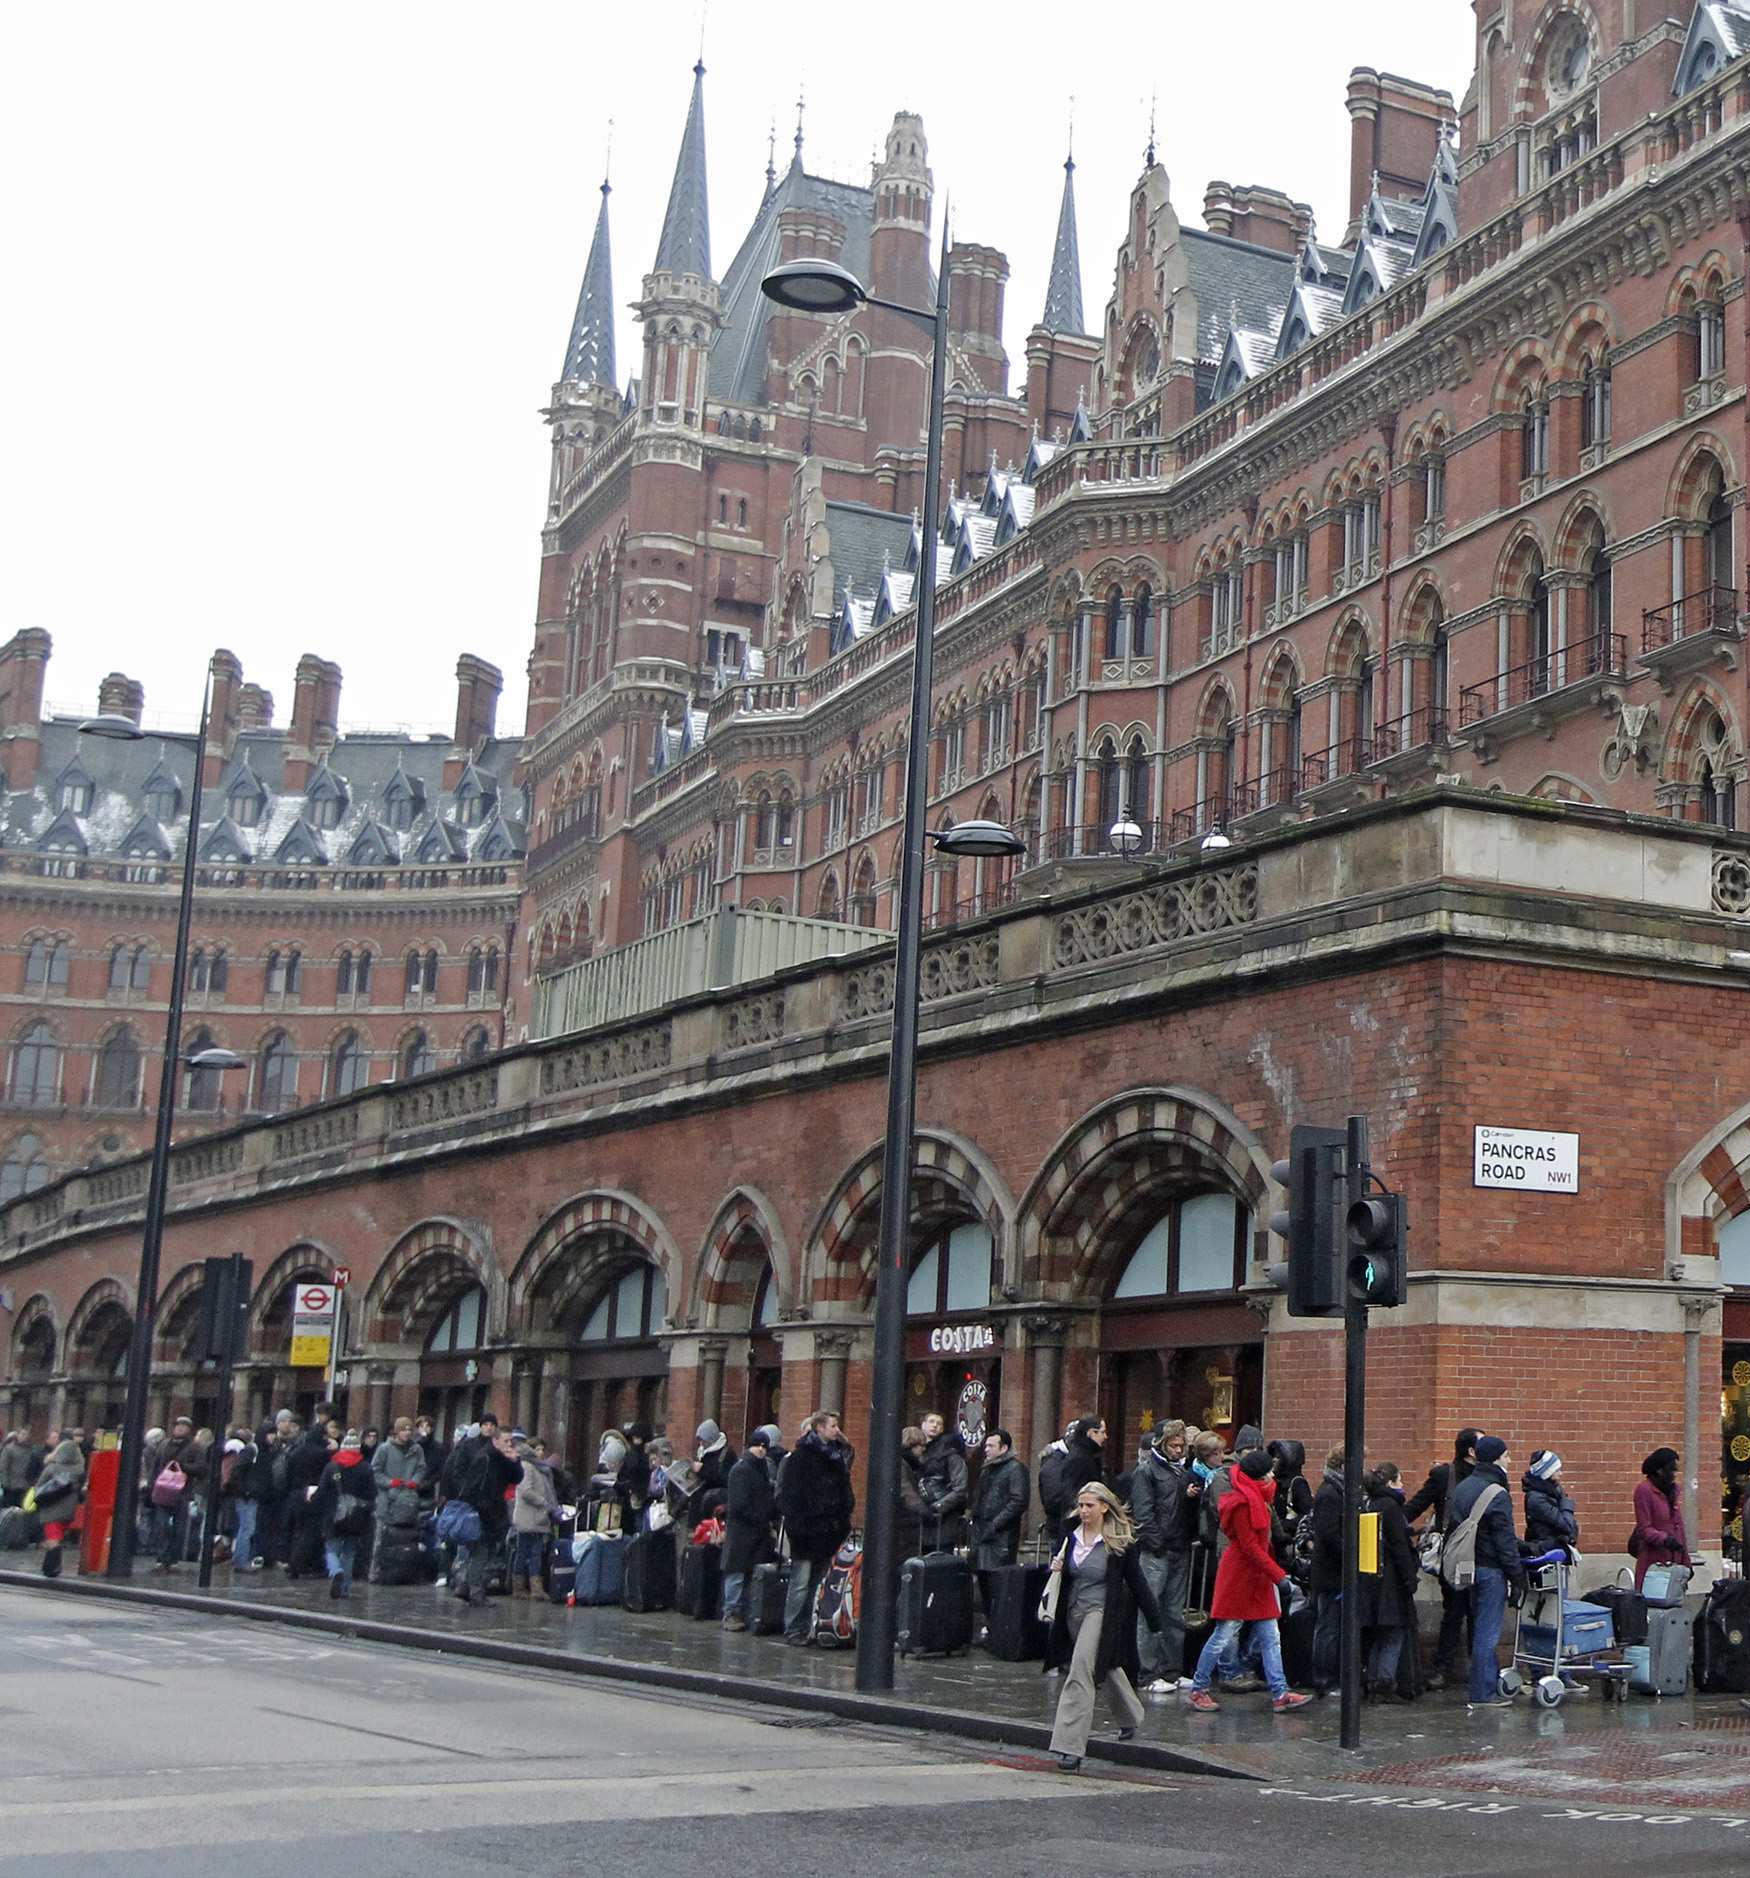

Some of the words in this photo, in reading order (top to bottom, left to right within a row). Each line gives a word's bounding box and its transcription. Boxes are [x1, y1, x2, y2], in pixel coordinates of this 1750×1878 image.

[1482, 1143, 1556, 1161] PANCRAS
[1482, 1164, 1525, 1180] ROAD
[1547, 1171, 1571, 1184] NW1
[335, 1271, 349, 1283] M
[930, 1325, 993, 1353] COSTA
[962, 1383, 987, 1402] COSTA
[1543, 1808, 1749, 1827] LOOK
